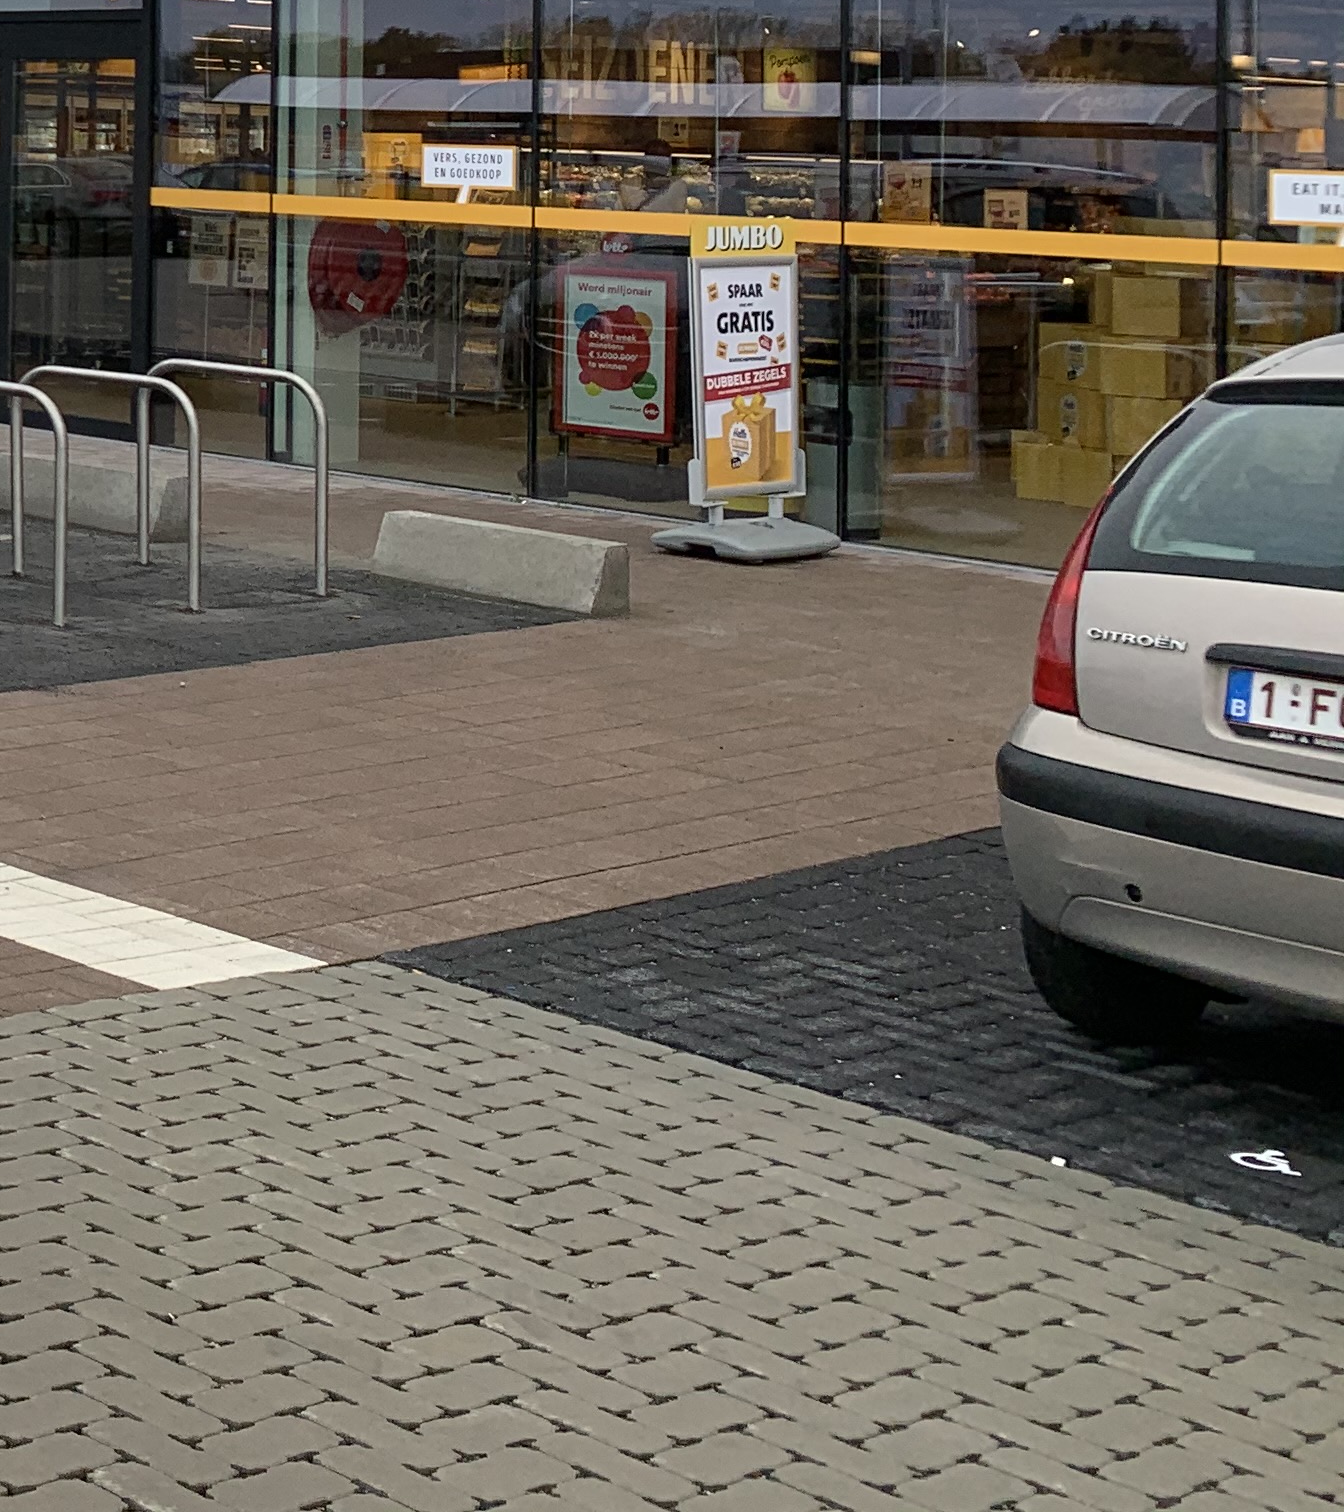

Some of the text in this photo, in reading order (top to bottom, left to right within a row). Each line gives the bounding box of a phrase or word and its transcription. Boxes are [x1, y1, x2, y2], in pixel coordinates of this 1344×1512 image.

[464, 152, 503, 165] GEZOND
[434, 167, 502, 179] EN GOEDKOOP
[1292, 182, 1319, 196] EAT
[705, 224, 784, 252] JUMBO
[577, 281, 653, 297] Word miljonair
[727, 282, 764, 299] SPAAR
[716, 309, 775, 335] GRATIS
[705, 372, 752, 391] DUBBELE
[752, 366, 787, 384] ZEGELS
[1086, 627, 1189, 653] CITROËN
[1230, 698, 1247, 717] B
[1260, 681, 1344, 728] 1-F
